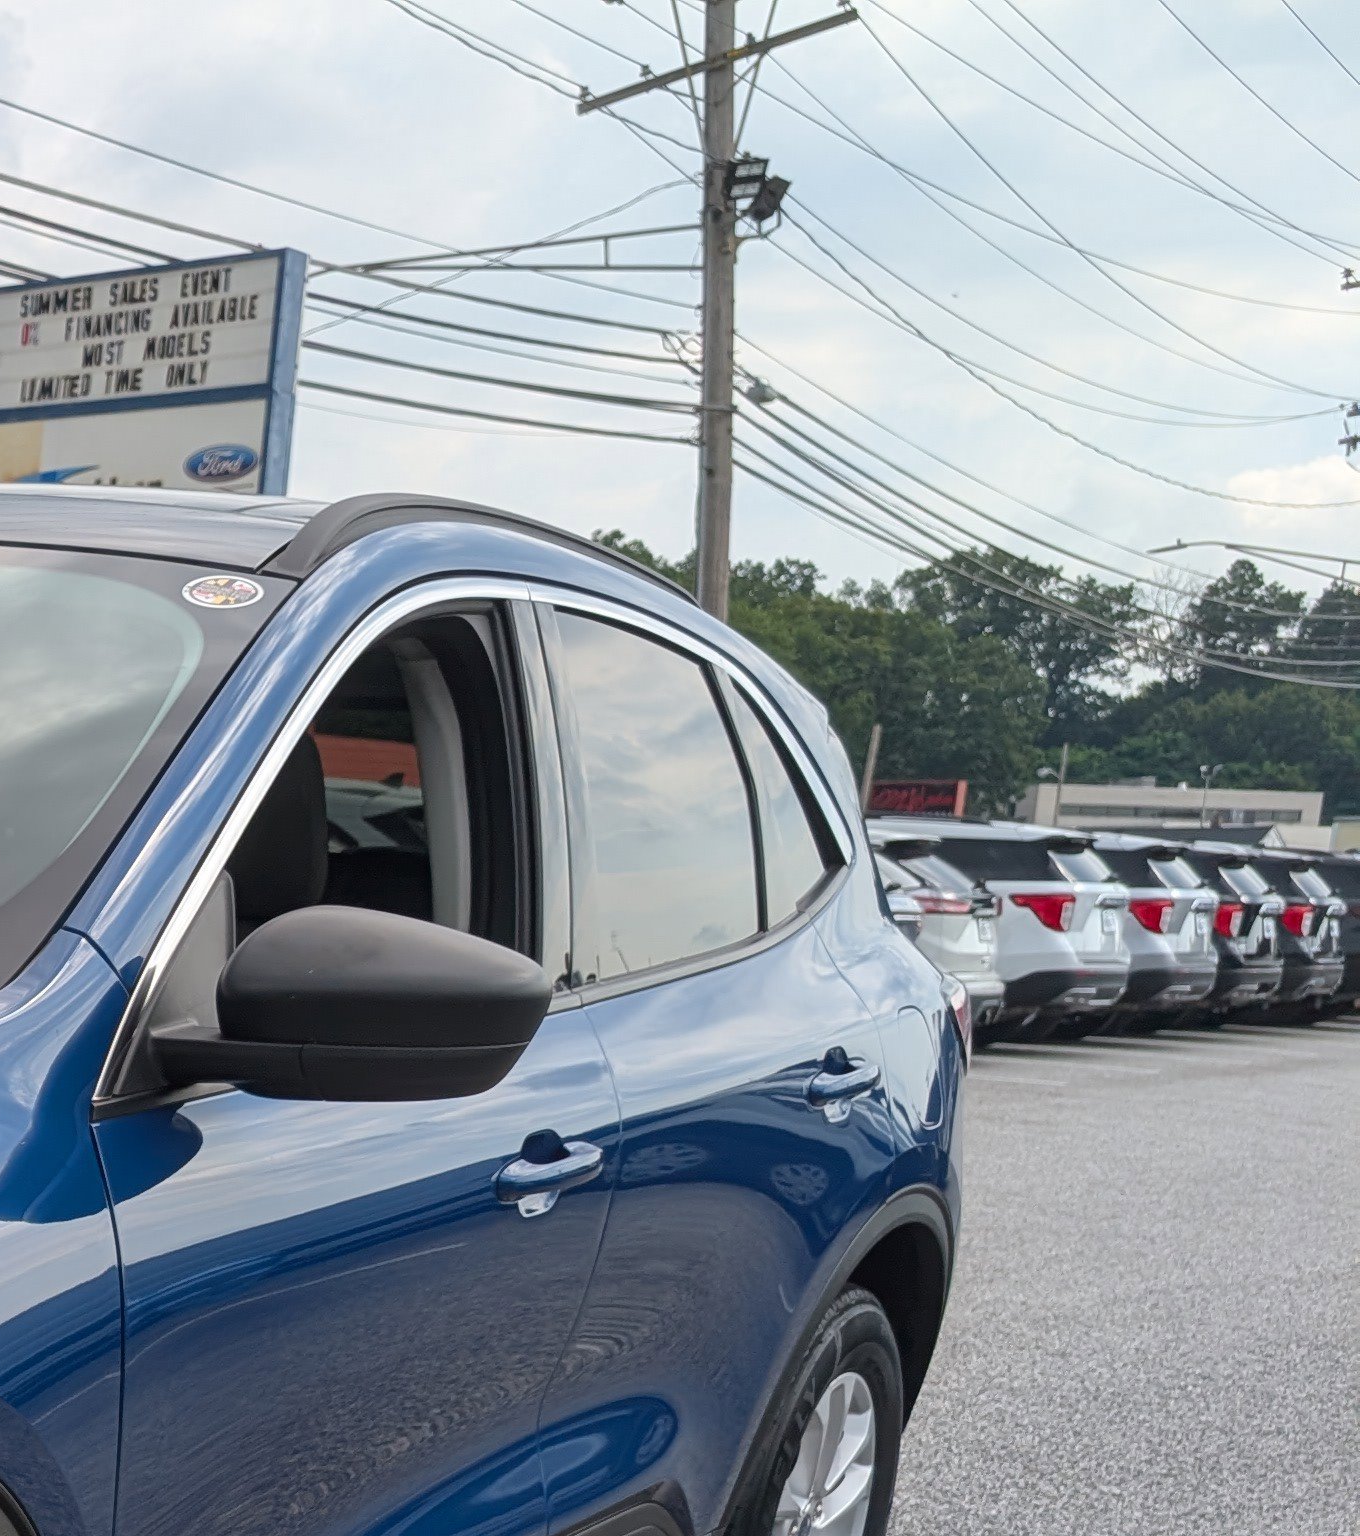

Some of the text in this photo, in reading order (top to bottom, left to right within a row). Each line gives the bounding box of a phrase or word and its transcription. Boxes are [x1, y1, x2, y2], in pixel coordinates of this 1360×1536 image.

[20, 267, 232, 318] SUMMER SALES EVENT
[65, 308, 152, 342] FINANCING
[169, 294, 259, 330] AVAILABLE
[82, 329, 211, 369] MOST MODELS
[20, 373, 92, 403] LIMITED
[166, 359, 209, 388] ONLY
